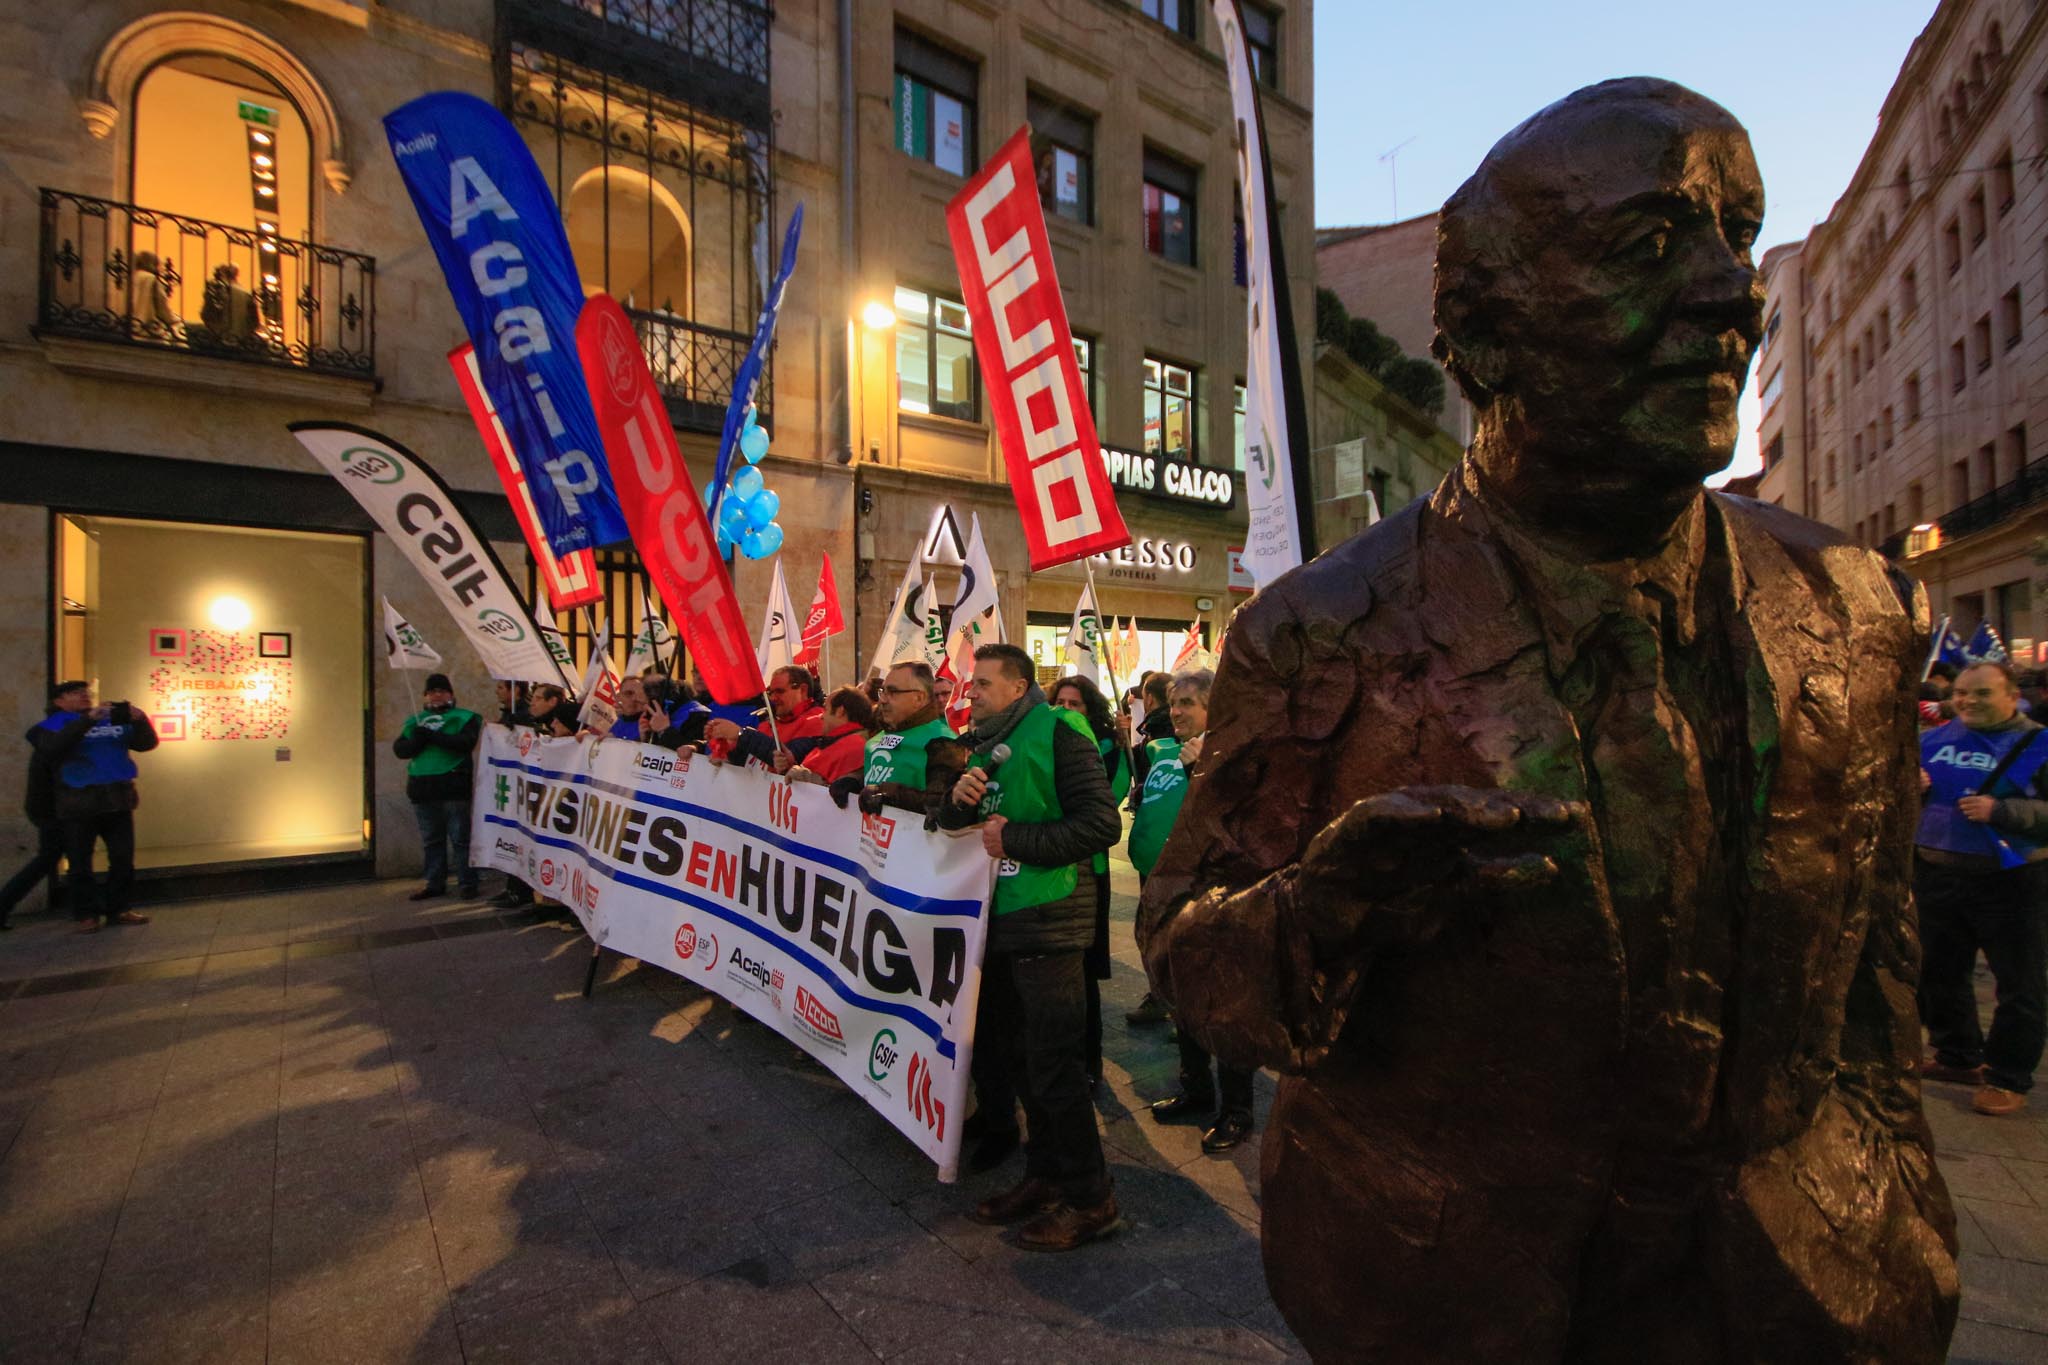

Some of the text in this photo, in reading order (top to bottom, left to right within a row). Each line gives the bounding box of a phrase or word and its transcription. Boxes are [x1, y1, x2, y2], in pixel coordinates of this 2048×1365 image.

[449, 155, 598, 517] Acaip
[964, 160, 1103, 548] CCOO
[1164, 462, 1233, 504] CALCO
[624, 396, 740, 668] UGT
[182, 679, 257, 691] REBAJAS
[633, 751, 673, 776] Acaip
[729, 947, 771, 987] Acaip
[807, 999, 837, 1035] CCOO
[874, 1042, 898, 1070] CSIF
